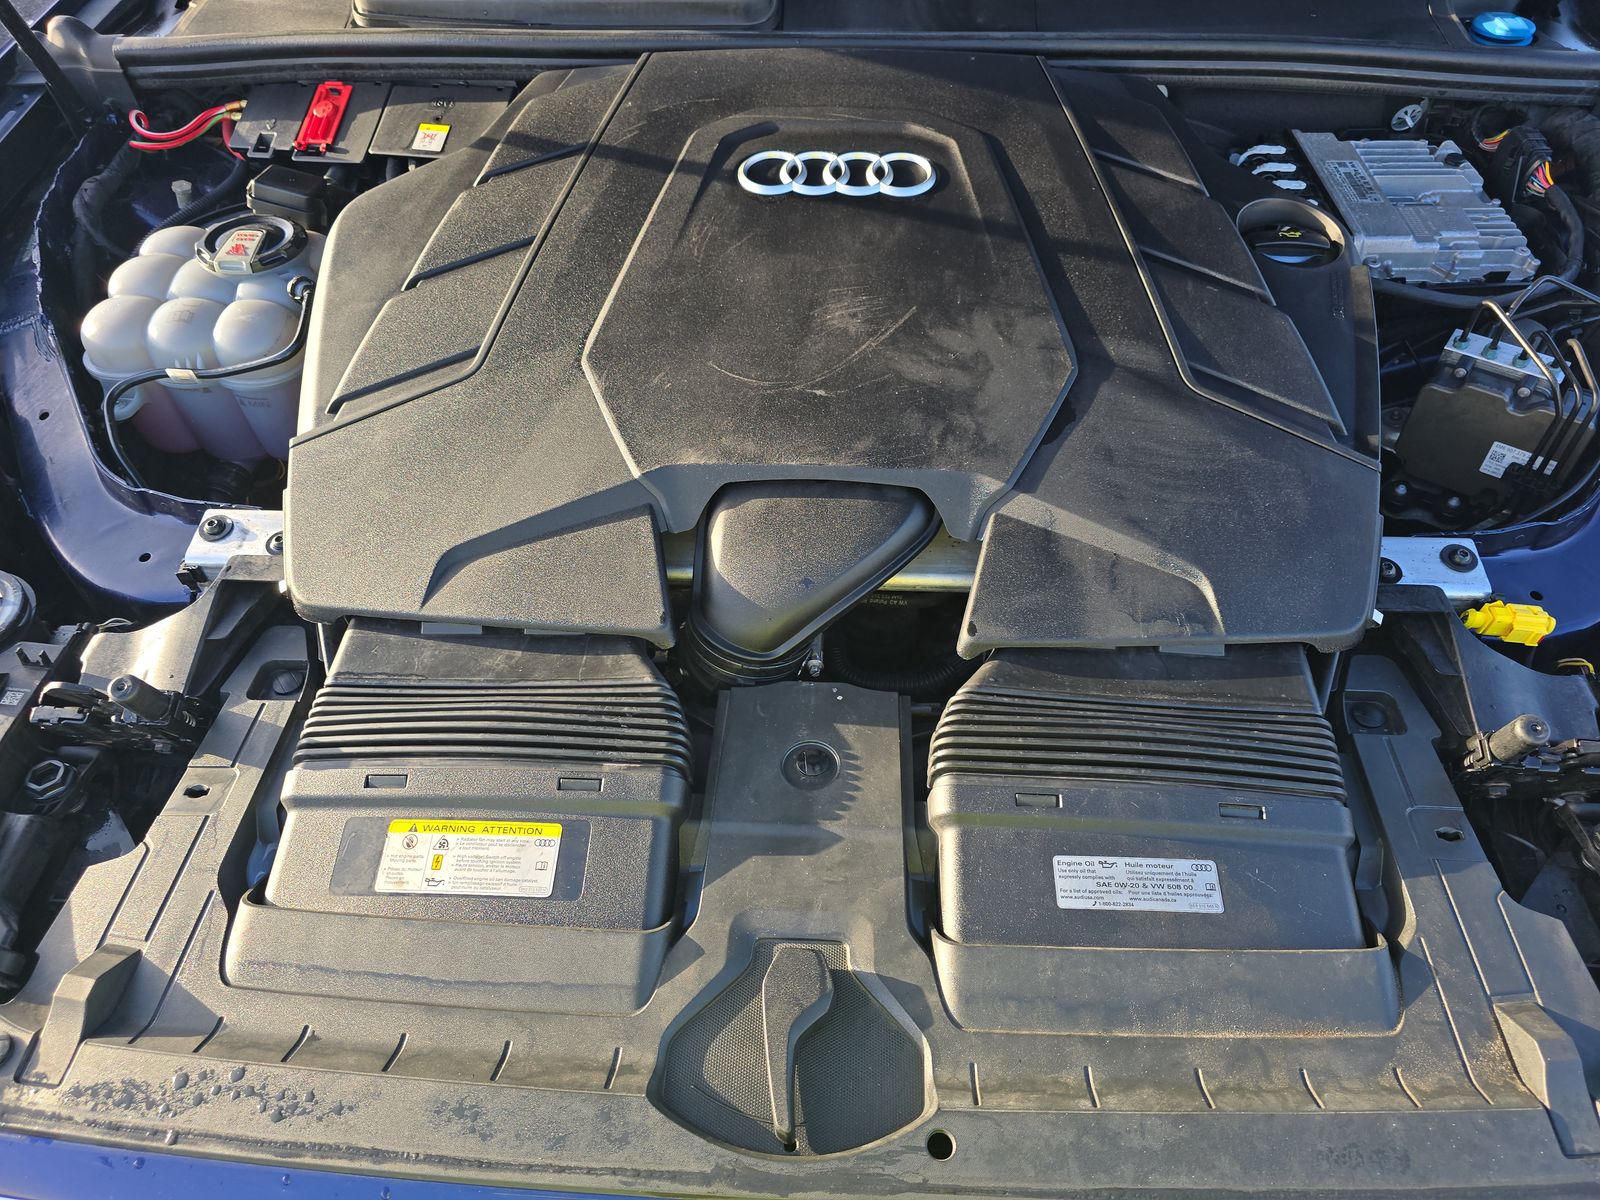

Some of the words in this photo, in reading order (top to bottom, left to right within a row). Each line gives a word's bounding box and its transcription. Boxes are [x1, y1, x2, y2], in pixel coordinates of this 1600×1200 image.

[423, 825, 476, 833] WARNING
[481, 826, 543, 835] ATTENTION
[1114, 881, 1140, 889] 0W-20
